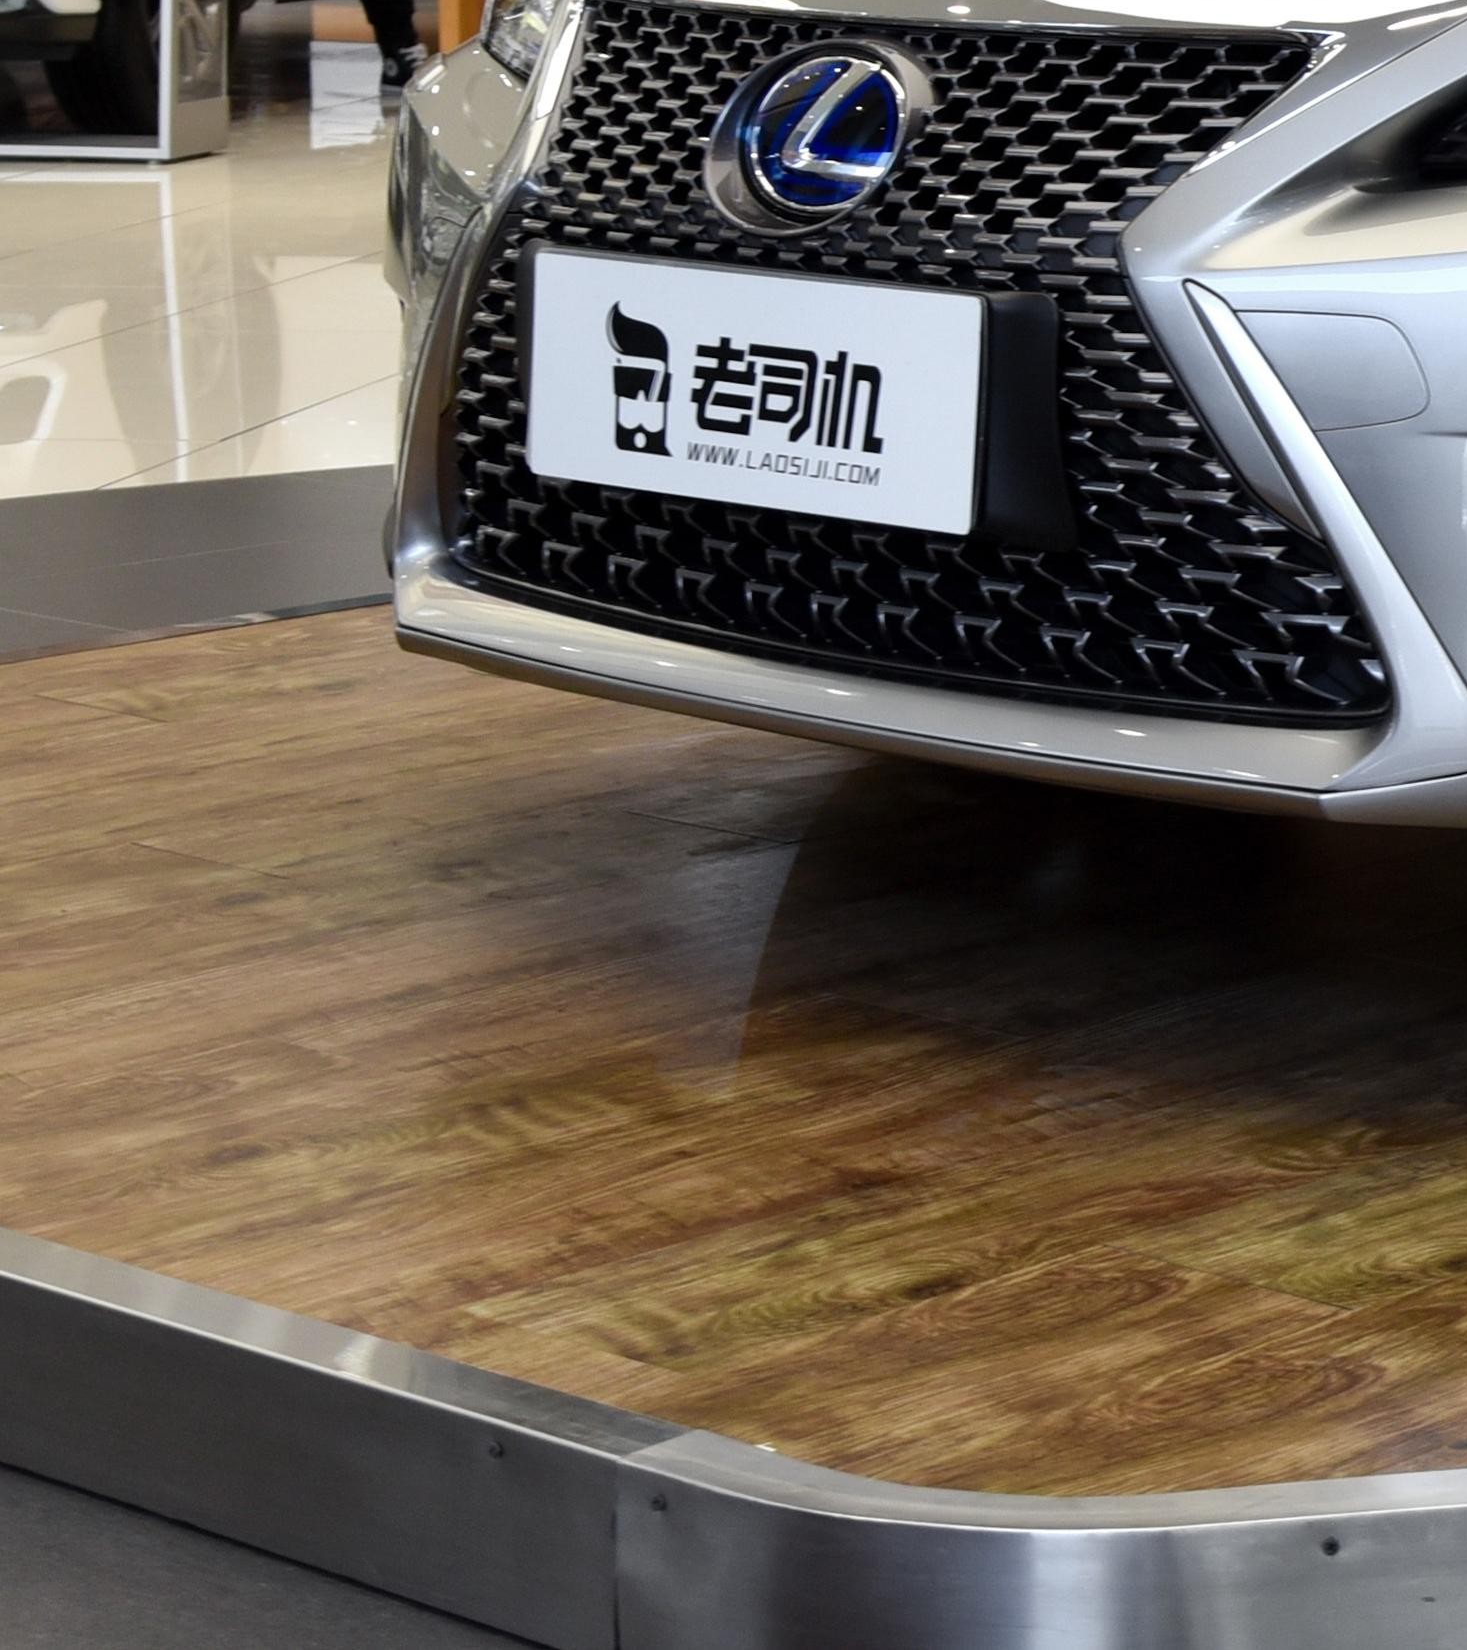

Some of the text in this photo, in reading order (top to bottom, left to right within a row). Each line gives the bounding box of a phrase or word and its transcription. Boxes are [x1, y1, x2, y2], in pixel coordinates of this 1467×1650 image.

[690, 336, 884, 454] 老司机
[687, 442, 882, 487] WWW.LAOSIJI.COM
